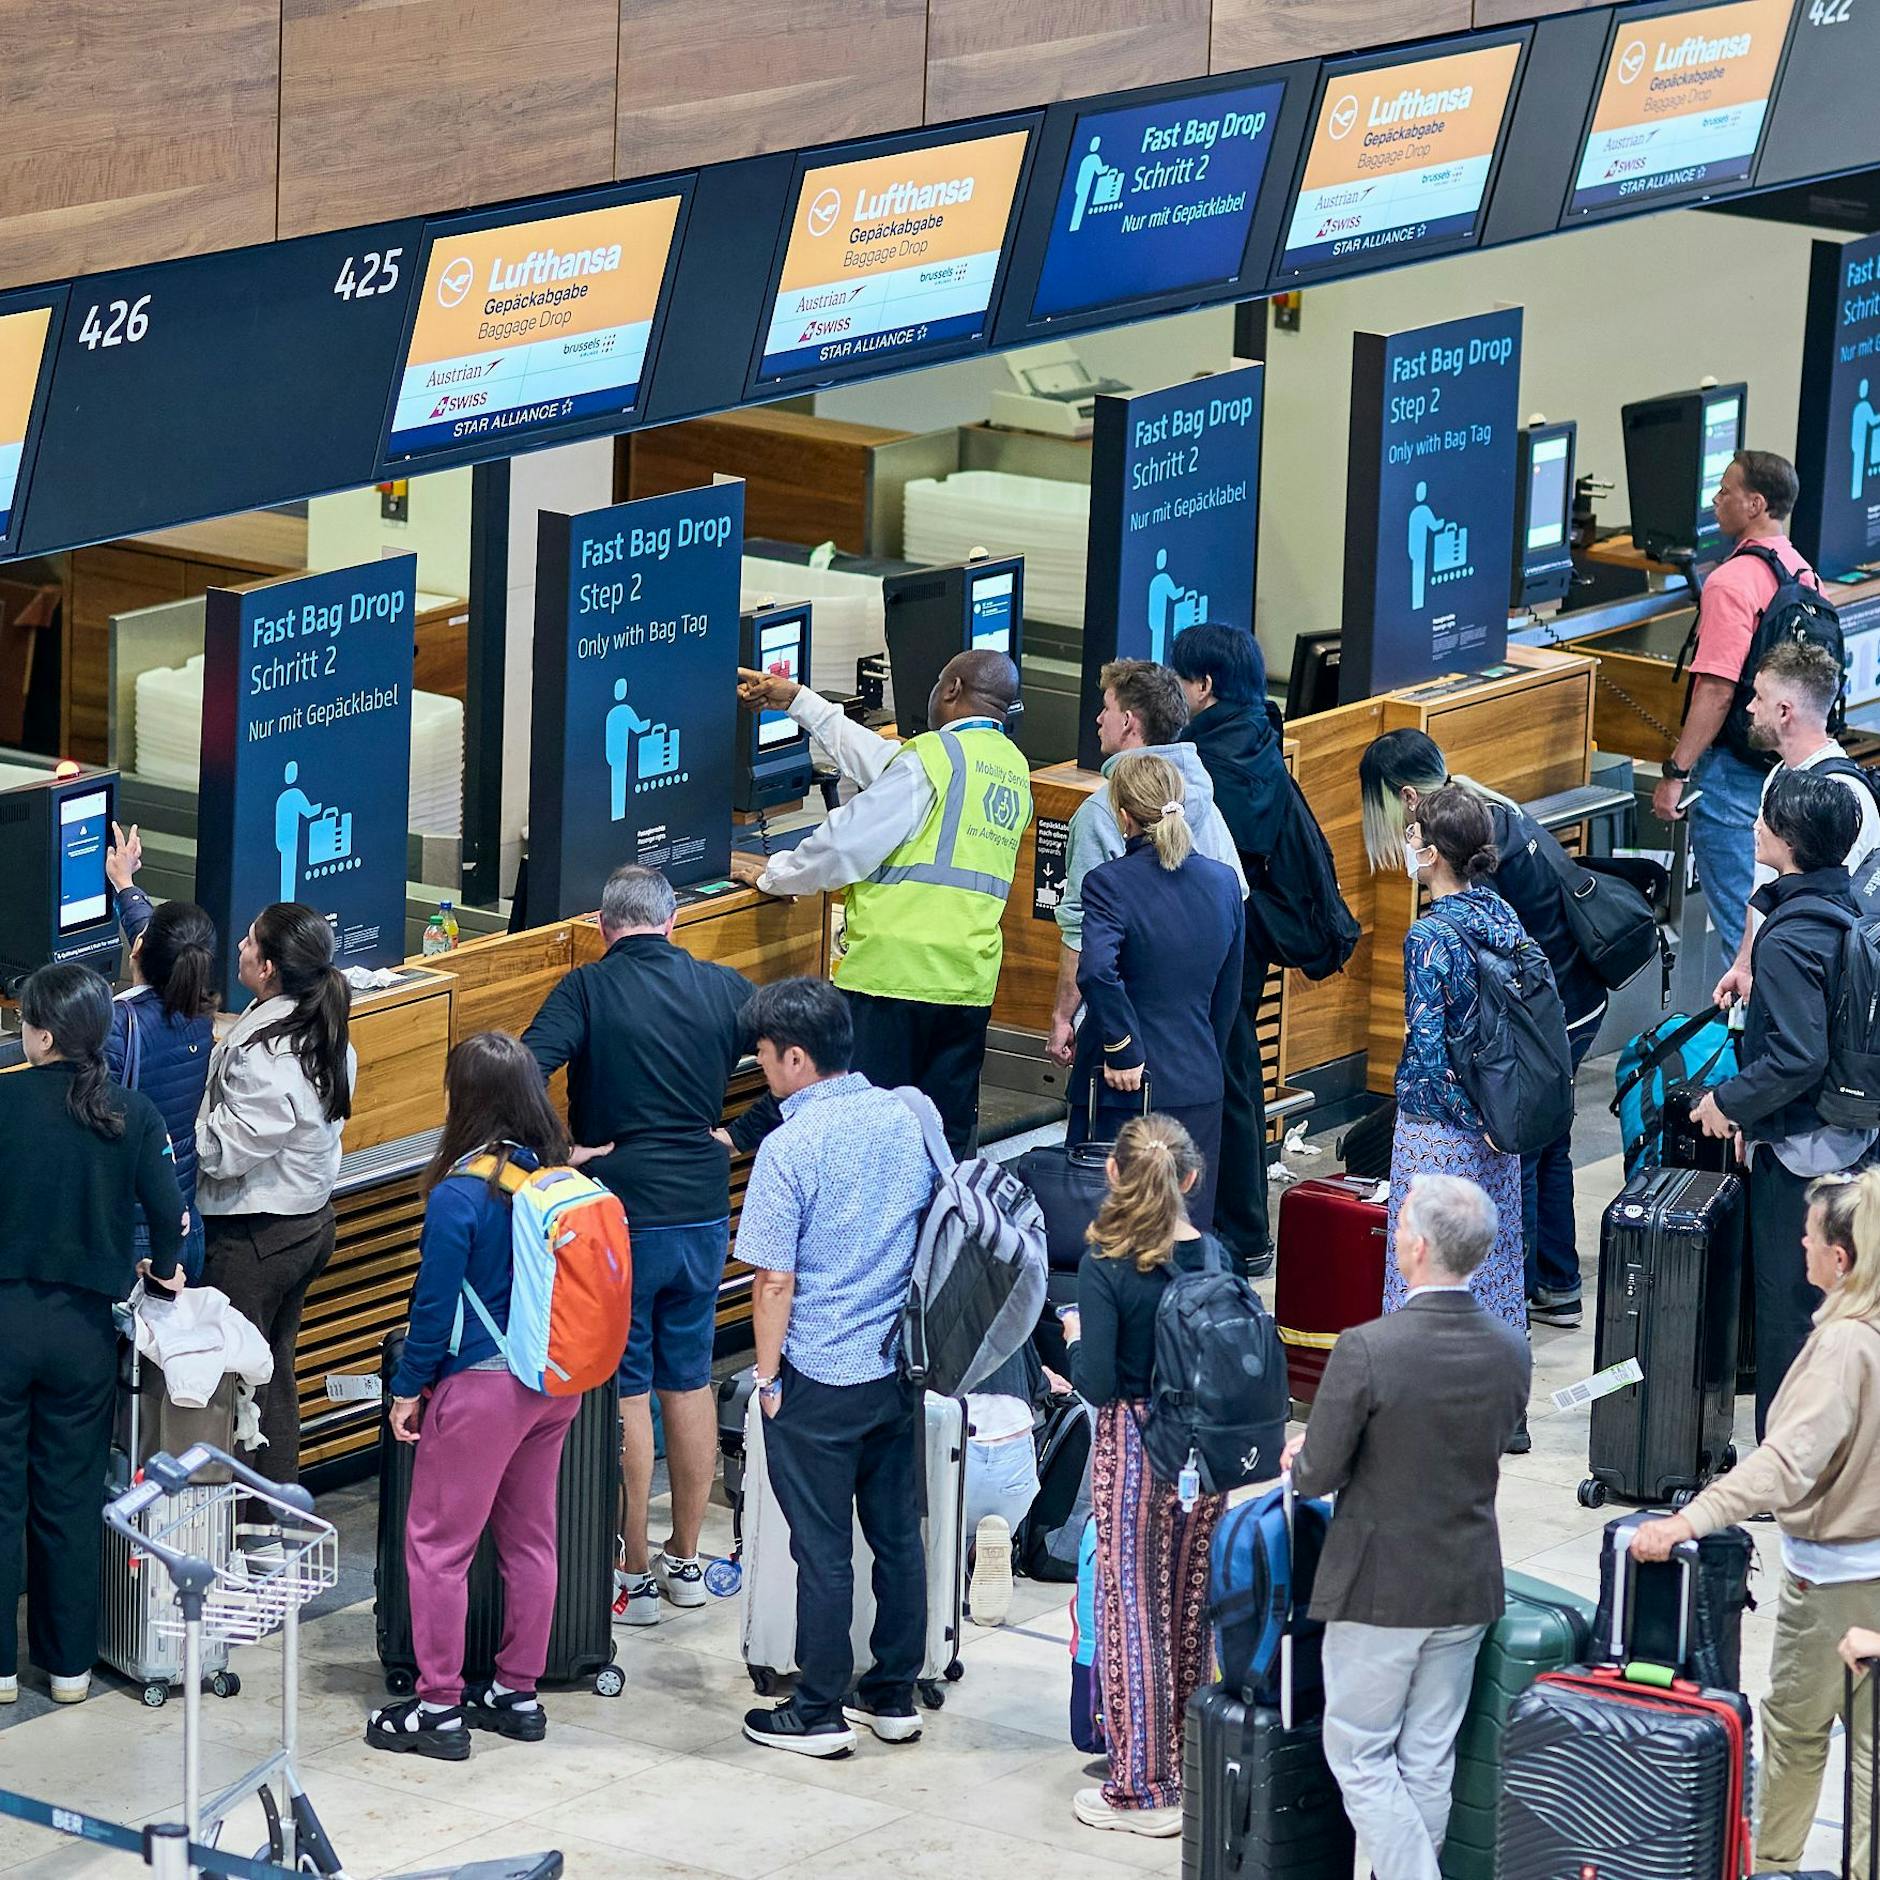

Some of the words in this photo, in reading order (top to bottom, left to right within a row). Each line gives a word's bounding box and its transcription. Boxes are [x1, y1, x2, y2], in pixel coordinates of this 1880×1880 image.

[1808, 0, 1853, 26] 422
[1654, 33, 1752, 72] Lufthansa
[1650, 67, 1725, 92] Gepäckabgabe
[1368, 85, 1473, 127] Lufthansa
[1141, 122, 1181, 153] Fast
[1183, 119, 1219, 149] Bag
[1221, 111, 1266, 140] Drop
[1363, 120, 1445, 147] Gepäckabgabe
[1357, 150, 1404, 169] Baggage
[1405, 144, 1431, 160] Drop
[1618, 157, 1647, 173] SWISS
[1131, 156, 1194, 194] Schritt
[1195, 155, 1210, 181] 2
[1619, 179, 1647, 195] STAR
[1647, 168, 1696, 190] ALLIANCE
[853, 176, 975, 222] Lufthansa
[1121, 215, 1147, 233] Nur
[1148, 207, 1171, 228] mit
[1172, 191, 1246, 225] Gepäcklabel
[1315, 190, 1359, 211] Austrian
[849, 214, 944, 245] Gepäckabgabe
[1331, 215, 1362, 233] SWISS
[843, 249, 896, 269] Baggage
[899, 239, 928, 257] Drop
[1332, 239, 1361, 256] STAR
[1361, 226, 1415, 250] ALLIANCE
[333, 248, 403, 301] 425
[488, 244, 622, 294] Lufthansa
[920, 266, 954, 283] brussels
[1847, 255, 1874, 288] Fast
[484, 283, 589, 316] Gepäckabgabe
[796, 290, 847, 313] Austrian
[78, 294, 152, 351] 426
[478, 320, 537, 340] Baggage
[540, 310, 572, 328] Drop
[816, 316, 851, 336] SWISS
[563, 337, 600, 355] brussels
[820, 342, 853, 361] STAR
[853, 328, 914, 355] ALLIANCE
[1393, 351, 1427, 383] Fast
[1431, 347, 1464, 376] Bag
[1469, 337, 1512, 366] Drop
[1840, 343, 1857, 363] Nur
[1858, 337, 1874, 356] mit
[426, 363, 482, 387] Austrian
[449, 391, 488, 413] SWISS
[1390, 395, 1425, 424] Step
[1430, 387, 1440, 413] 2
[453, 417, 488, 438] STAR
[490, 402, 559, 430] ALLIANCE
[1135, 414, 1168, 448] Fast
[1172, 409, 1204, 439] Bag
[1209, 397, 1253, 427] Drop
[1389, 441, 1413, 464] Only
[1416, 433, 1441, 456] with
[1444, 430, 1466, 451] Bag
[1470, 424, 1492, 445] Tag
[1132, 450, 1184, 491] Schritt
[1188, 446, 1199, 473] 2
[1130, 512, 1150, 532] Nur
[1152, 501, 1171, 524] mit
[1174, 480, 1246, 518] Gepäcklabel
[582, 532, 624, 569] Fast
[630, 528, 671, 560] Bag
[678, 515, 731, 547] Drop
[579, 582, 624, 614] Step
[630, 572, 642, 602] 2
[252, 609, 296, 648] Fast
[301, 604, 343, 638] Bag
[350, 590, 404, 624] Drop
[577, 633, 610, 660] Only
[613, 624, 645, 650] with
[650, 620, 676, 644] Bag
[681, 613, 708, 637] Tag
[250, 650, 319, 695] Schritt
[324, 645, 337, 675] 2
[249, 719, 275, 742] Nur
[279, 708, 303, 733] mit
[306, 683, 399, 727] Gepäcklabel
[975, 760, 1007, 783] Mobility
[1007, 770, 1030, 789] Servic
[966, 824, 978, 836] im
[1038, 829, 1053, 838] nach
[1038, 846, 1062, 856] upwards
[52, 1808, 83, 1834] BER
